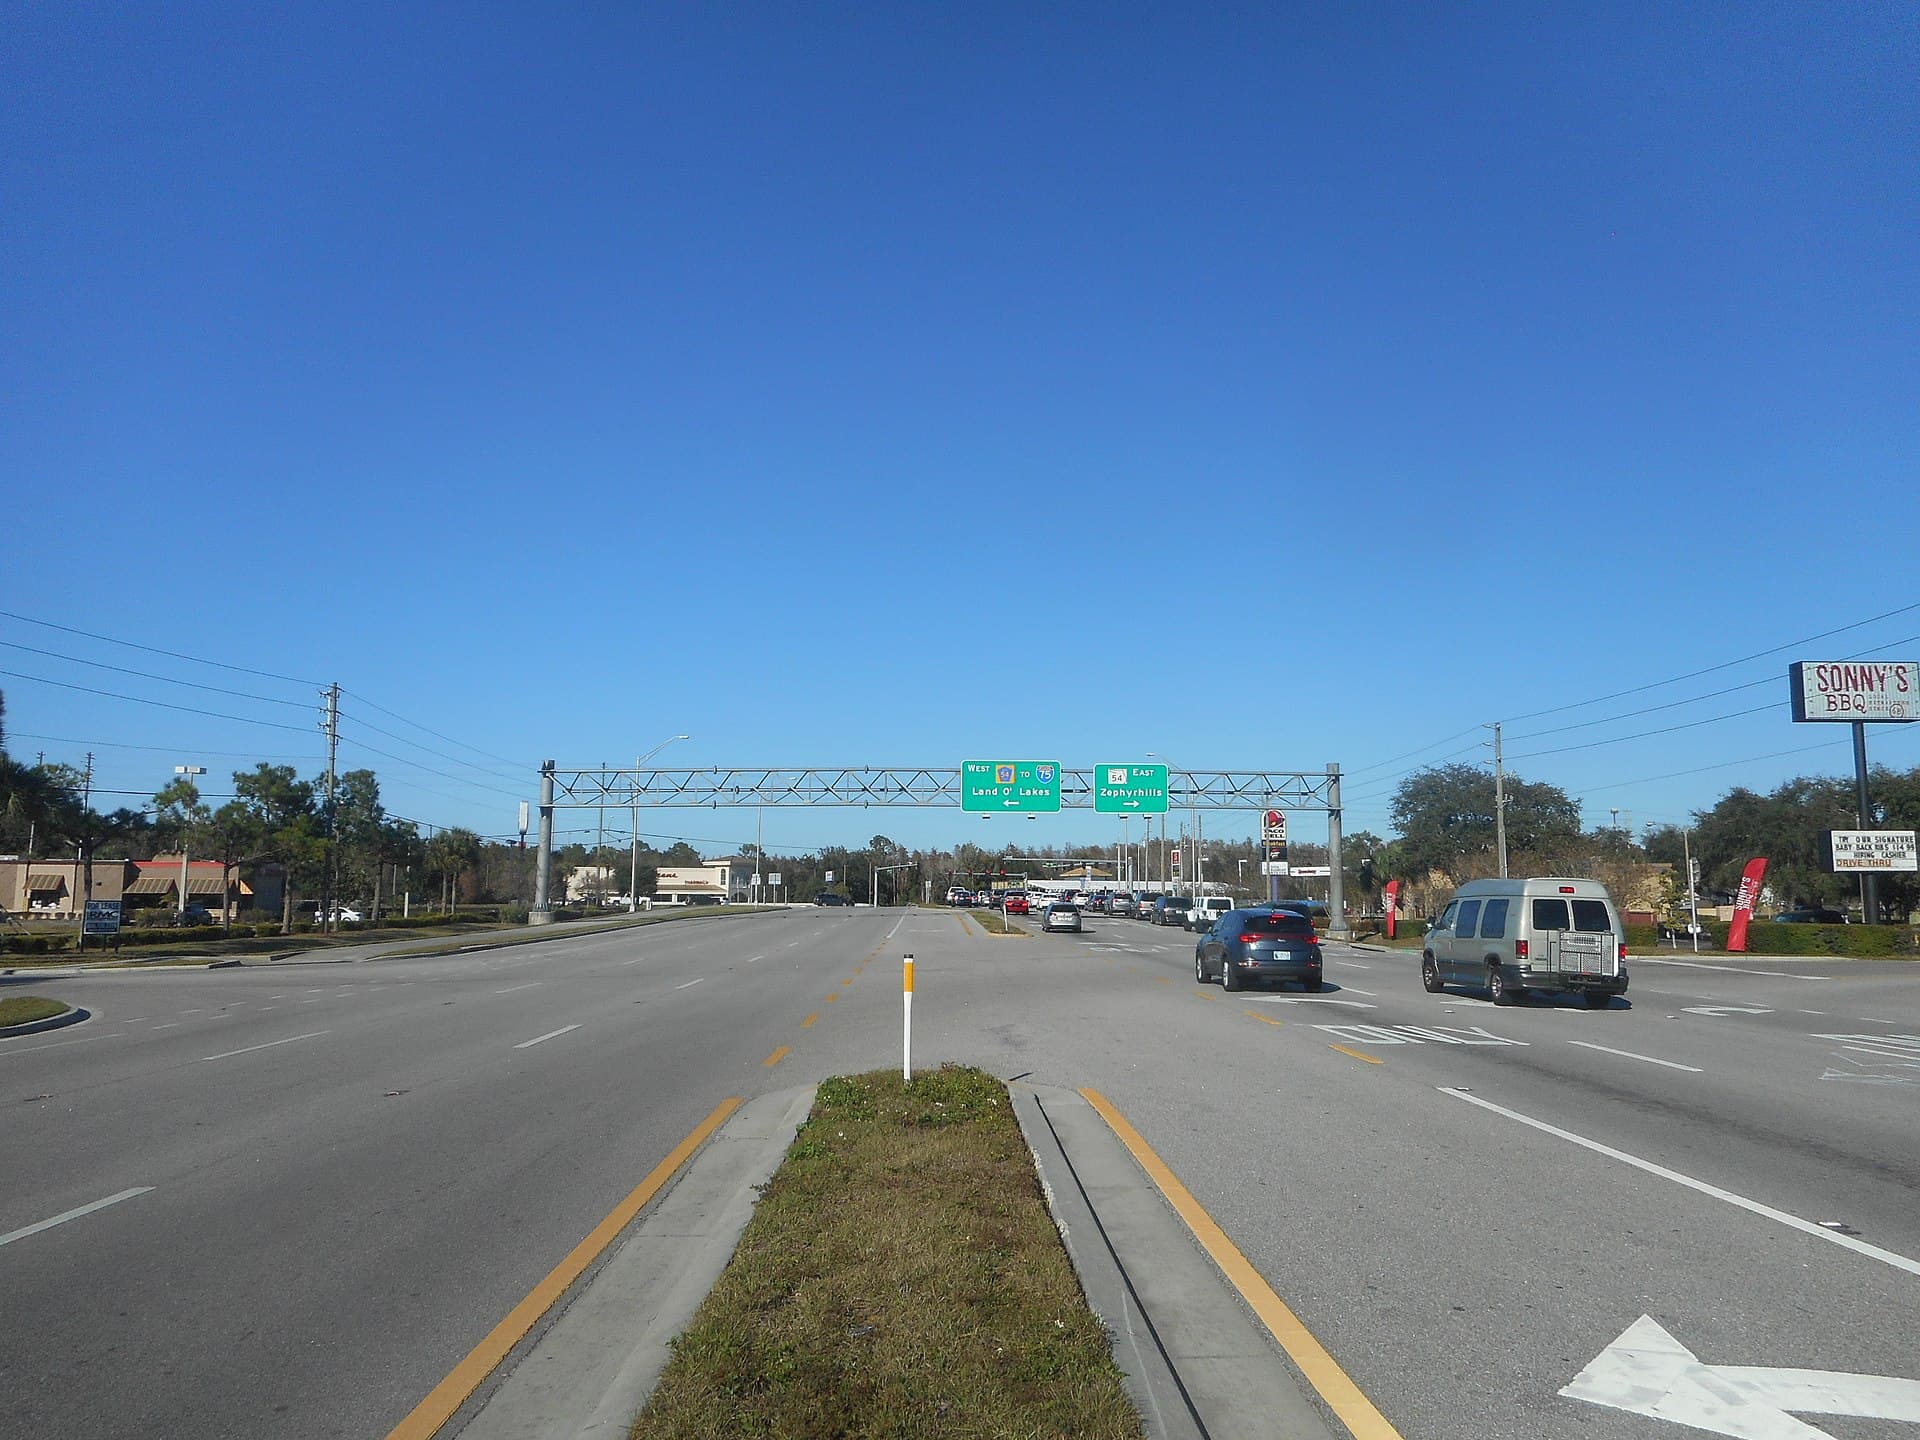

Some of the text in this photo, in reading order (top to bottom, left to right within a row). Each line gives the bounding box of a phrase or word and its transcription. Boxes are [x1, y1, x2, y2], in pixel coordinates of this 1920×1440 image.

[1816, 664, 1909, 692] SONNY'S
[1825, 694, 1867, 714] BBQ
[967, 764, 990, 772] WEST
[1039, 770, 1052, 779] 75
[1111, 768, 1154, 782] 54 EAST
[972, 787, 998, 796] Land
[1019, 787, 1050, 796] Lakes
[1100, 787, 1163, 798] Zephyrhills
[1836, 859, 1892, 867] DRIVE THRU
[1736, 877, 1751, 910] SONNY'S
